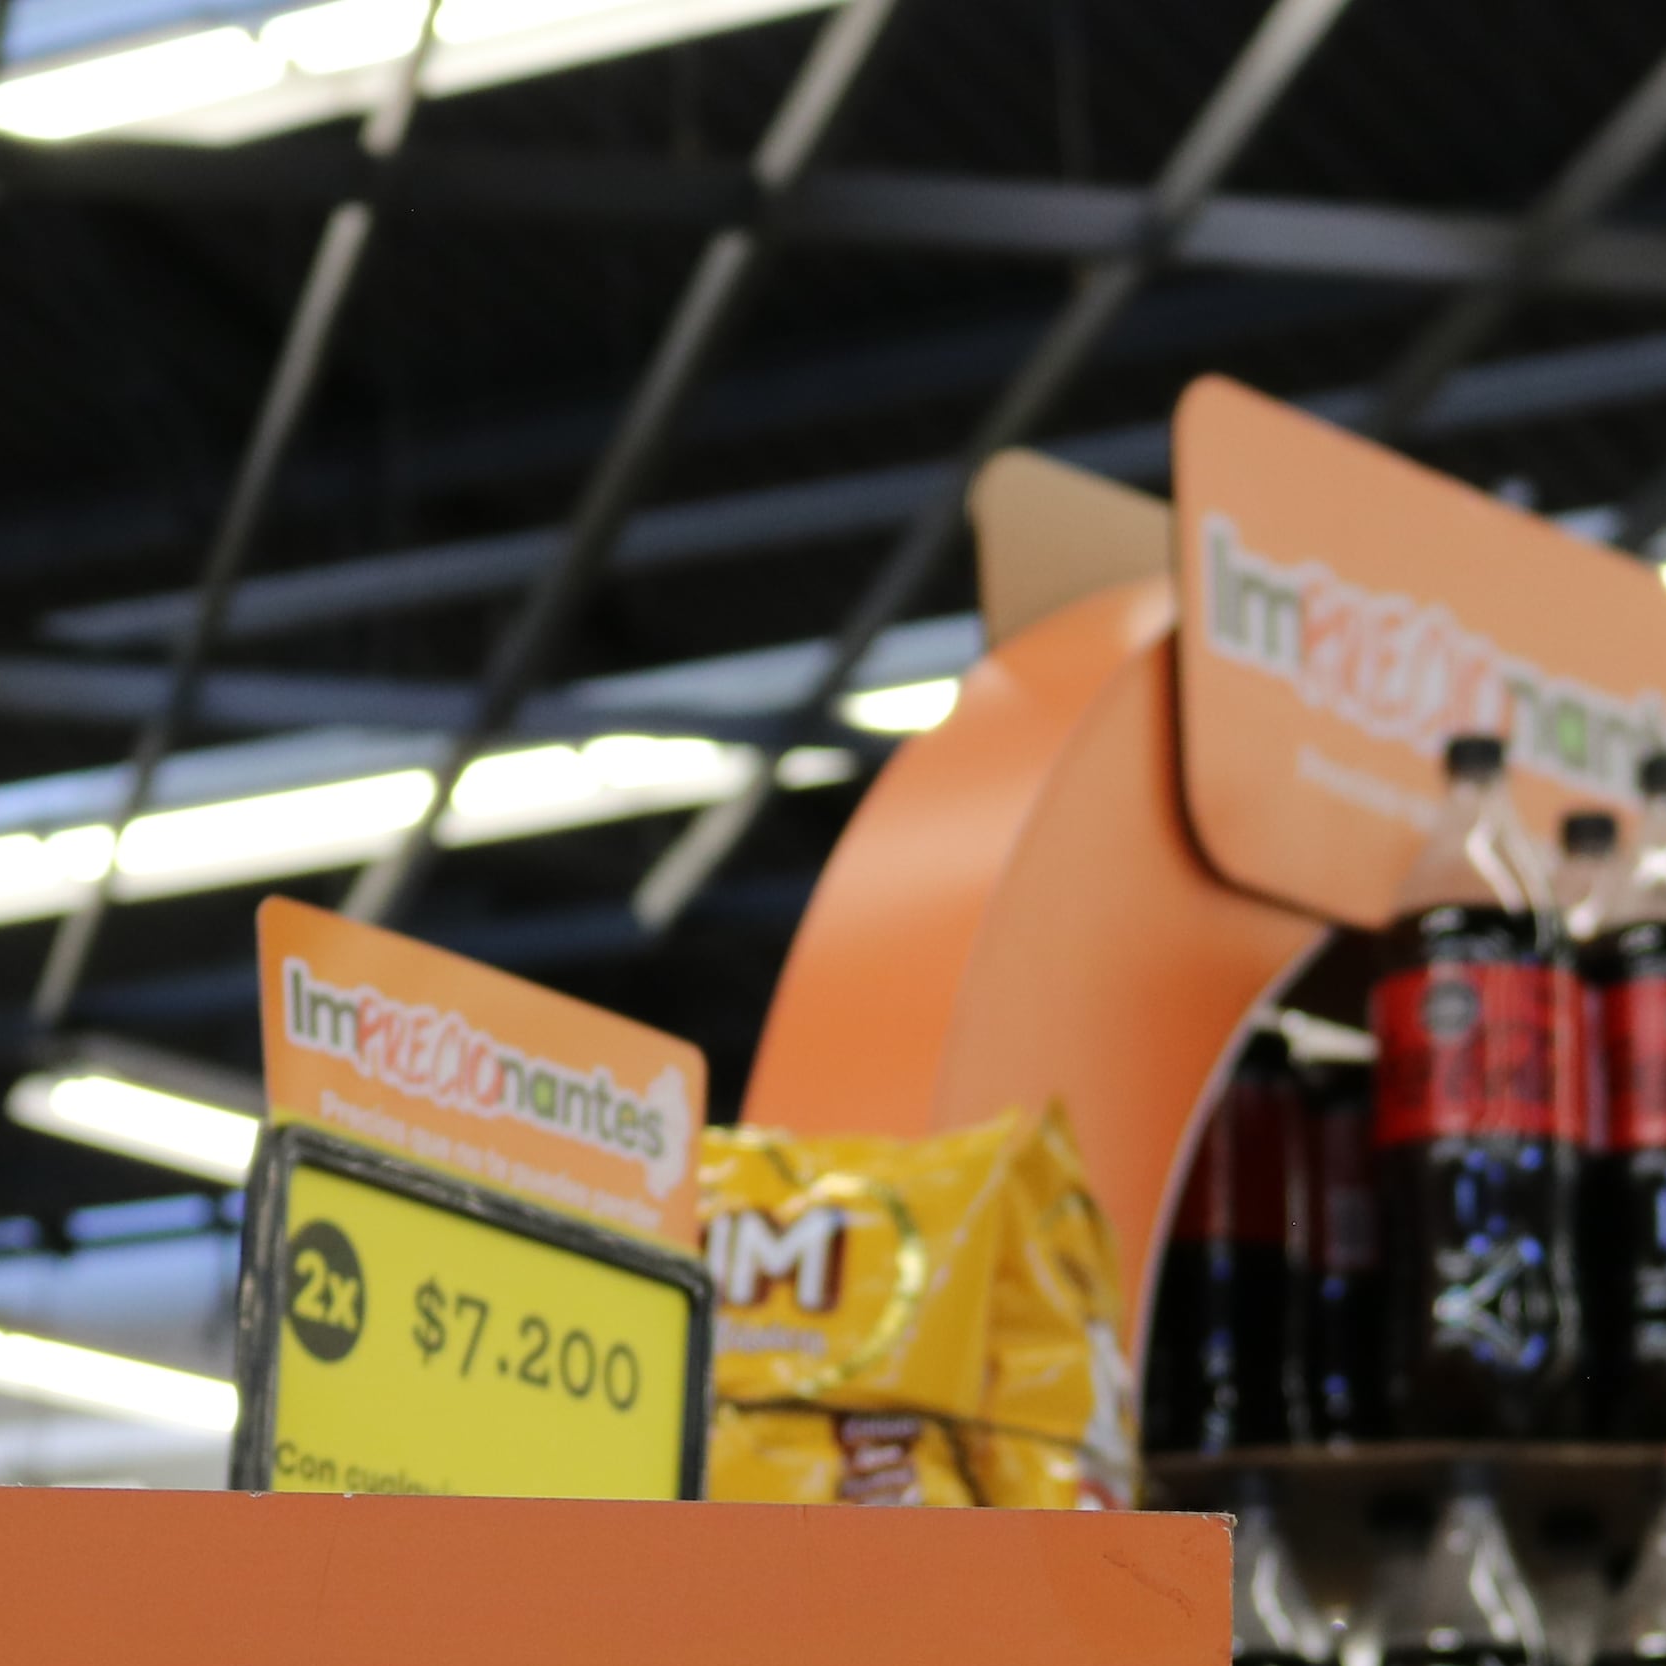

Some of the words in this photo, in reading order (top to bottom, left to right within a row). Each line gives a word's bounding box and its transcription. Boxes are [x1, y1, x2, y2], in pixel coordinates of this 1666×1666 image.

[293, 1249, 360, 1332] 2x
[411, 1274, 641, 1413] $7.200
[274, 1441, 335, 1484] Con
